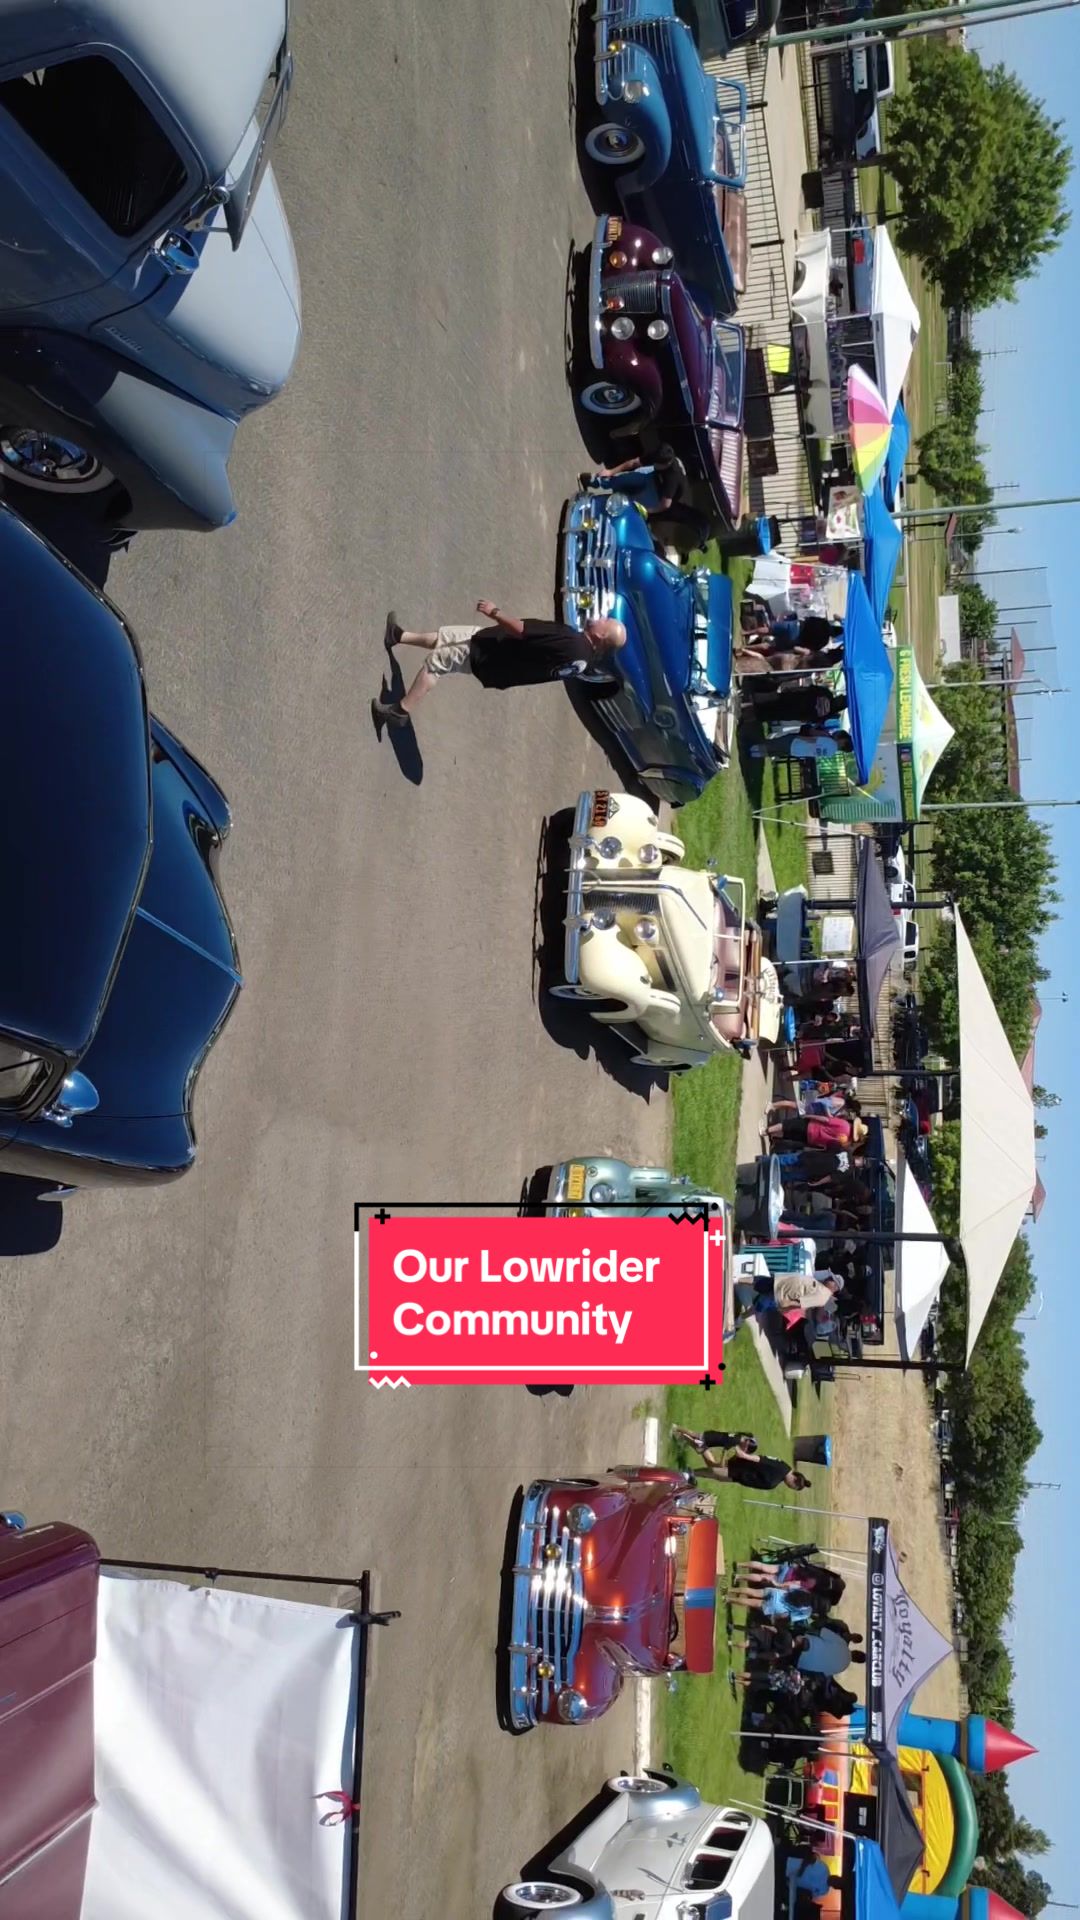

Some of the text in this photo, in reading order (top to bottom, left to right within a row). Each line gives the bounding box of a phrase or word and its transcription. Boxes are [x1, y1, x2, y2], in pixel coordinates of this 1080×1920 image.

[899, 658, 912, 687] FRESH
[899, 689, 912, 739] LEMONADE
[903, 768, 913, 788] FRESH
[872, 1588, 883, 1687] LOYALTY_CARCLUB
[892, 1595, 916, 1688] Loyalty
